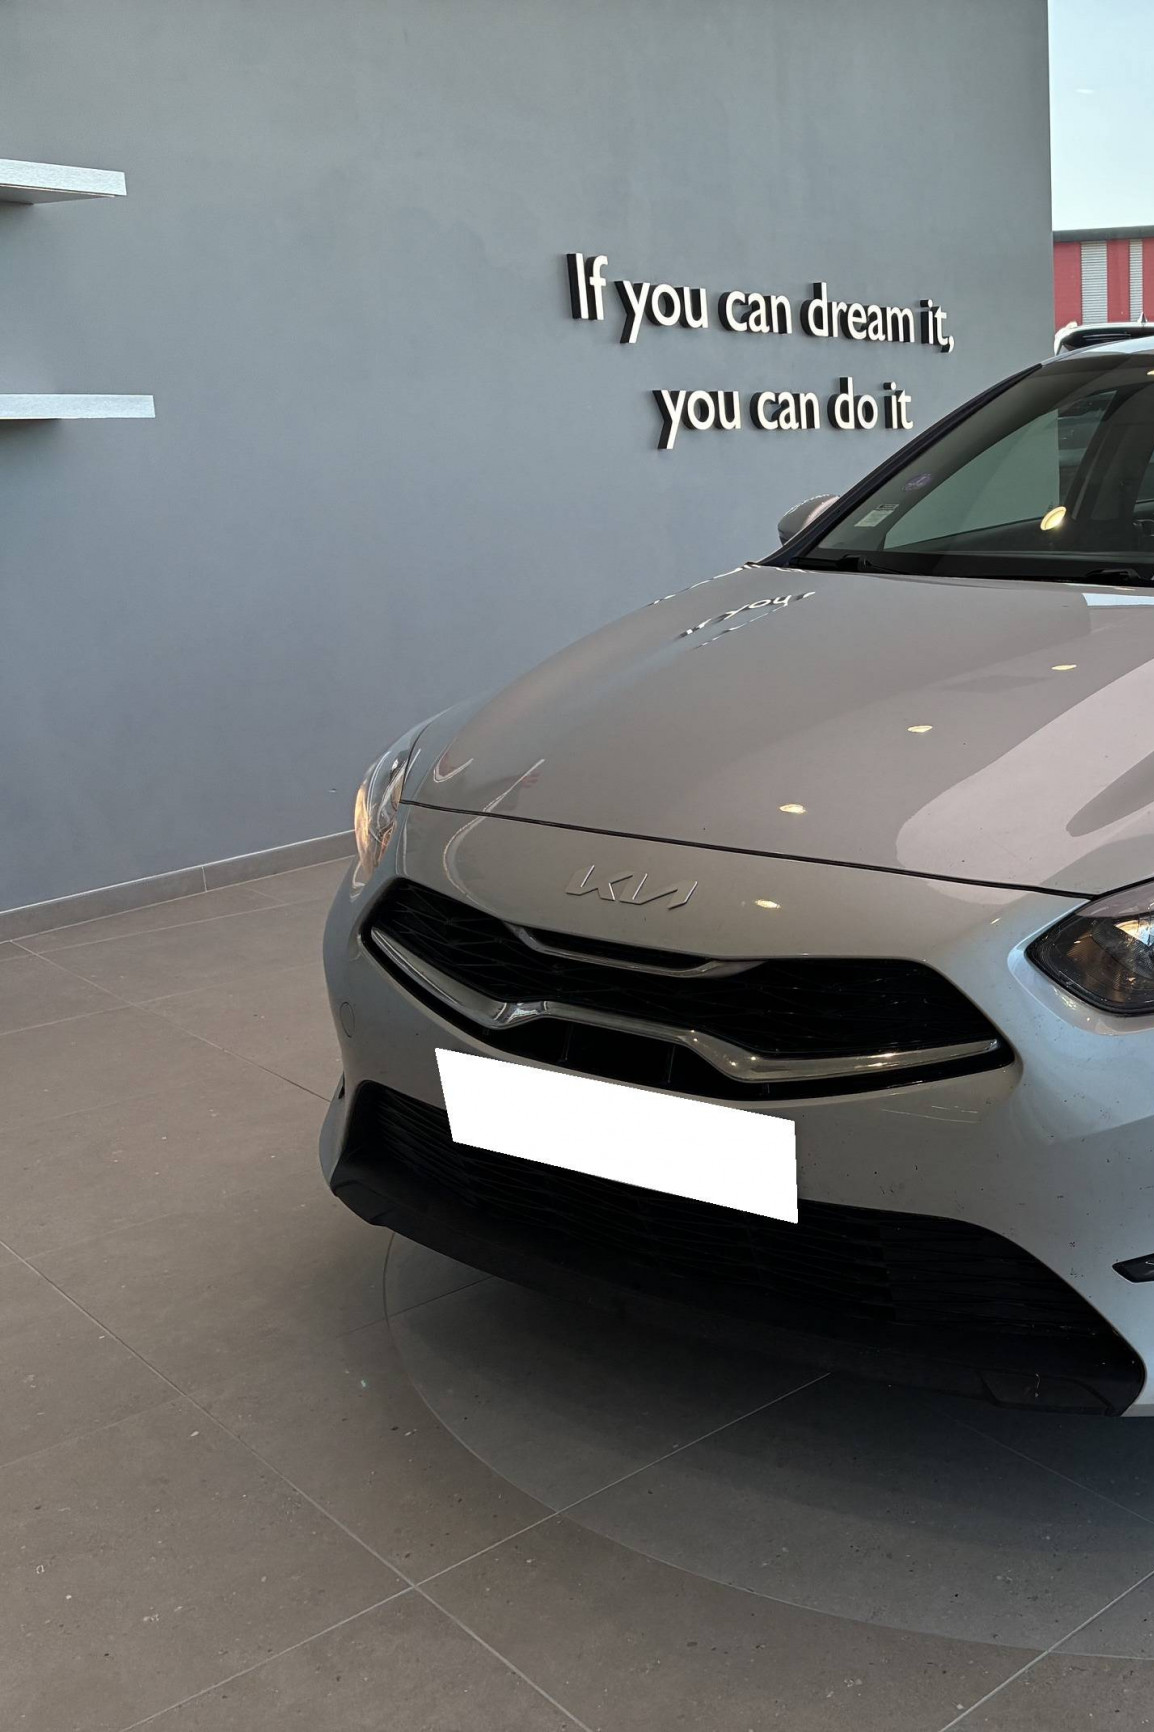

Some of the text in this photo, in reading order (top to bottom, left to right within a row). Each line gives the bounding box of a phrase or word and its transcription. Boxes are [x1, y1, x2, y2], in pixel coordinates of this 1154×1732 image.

[566, 253, 955, 353] If you can dream it,
[652, 377, 914, 450] you can do it
[565, 864, 698, 911] KIA
